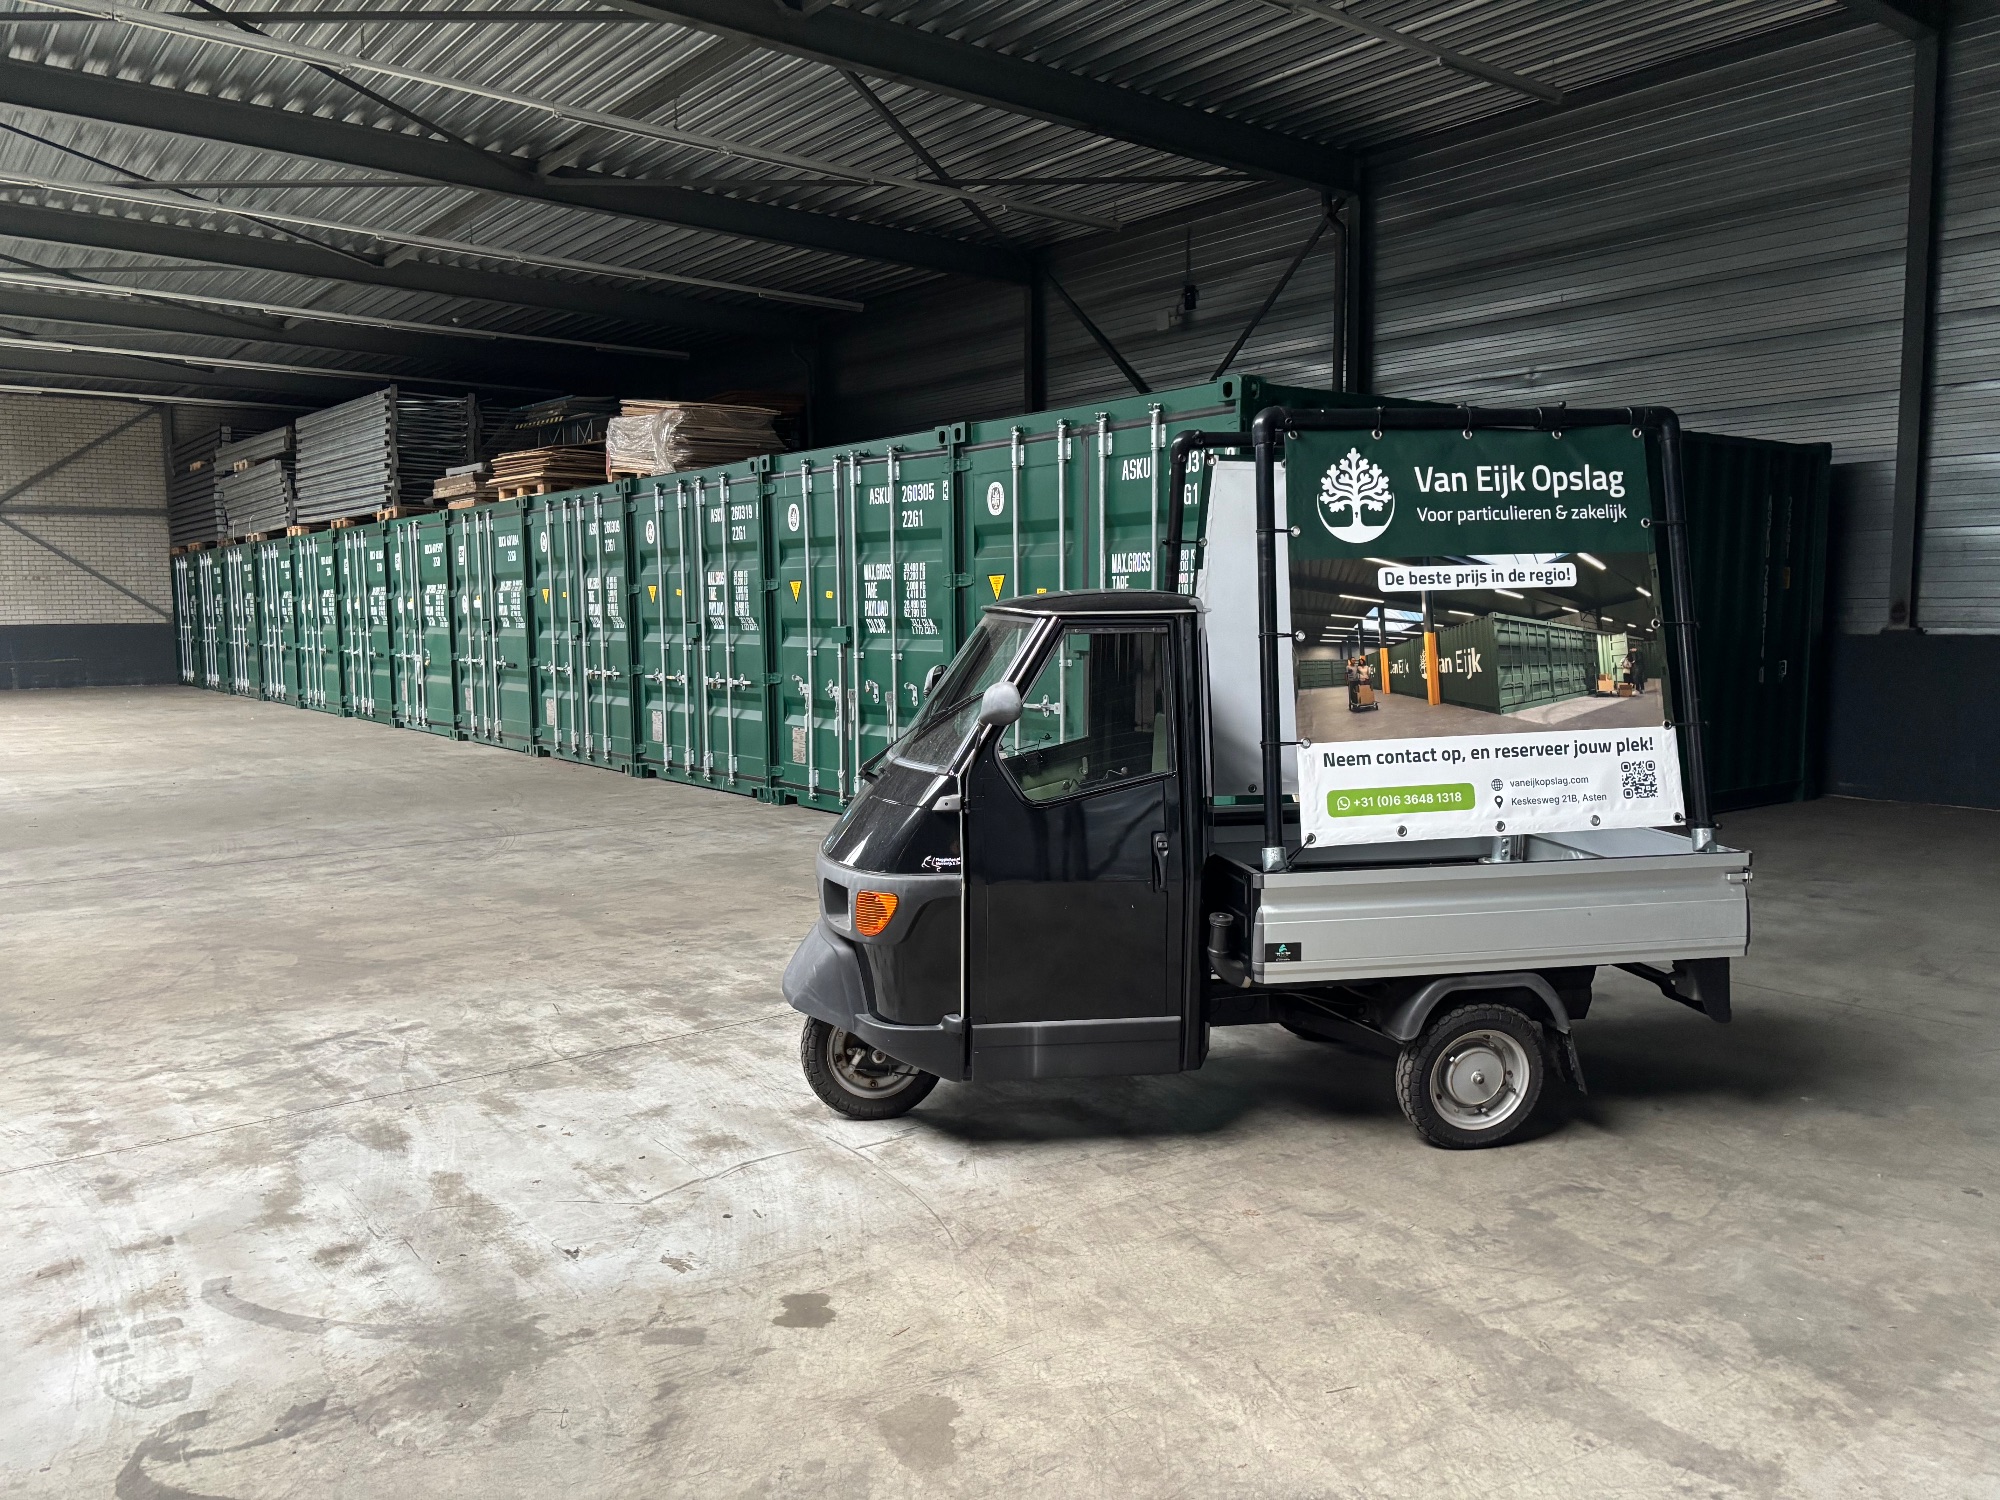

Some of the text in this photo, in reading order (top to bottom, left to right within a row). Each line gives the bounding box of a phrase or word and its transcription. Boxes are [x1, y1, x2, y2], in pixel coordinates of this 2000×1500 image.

[1122, 457, 1151, 480] ASKU
[1414, 463, 1626, 499] Van Eijk Opslag
[902, 482, 935, 503] 260305
[1180, 483, 1199, 505] G1
[902, 509, 924, 528] 22G1
[1417, 504, 1628, 525] Voor particulieren & zakelijk
[1112, 552, 1151, 573] MAX.GROSS
[1384, 567, 1571, 587] De beste prijs in de regio!
[1438, 647, 1483, 680] an Eijk
[1323, 736, 1654, 767] Neem contact op, en reserveer jouw plek!
[1510, 776, 1589, 788] vaneijkopslag.com
[1353, 792, 1462, 808] +31 (0)6 3648 1318
[1511, 793, 1607, 807] Keskesweg 21B, Asten
